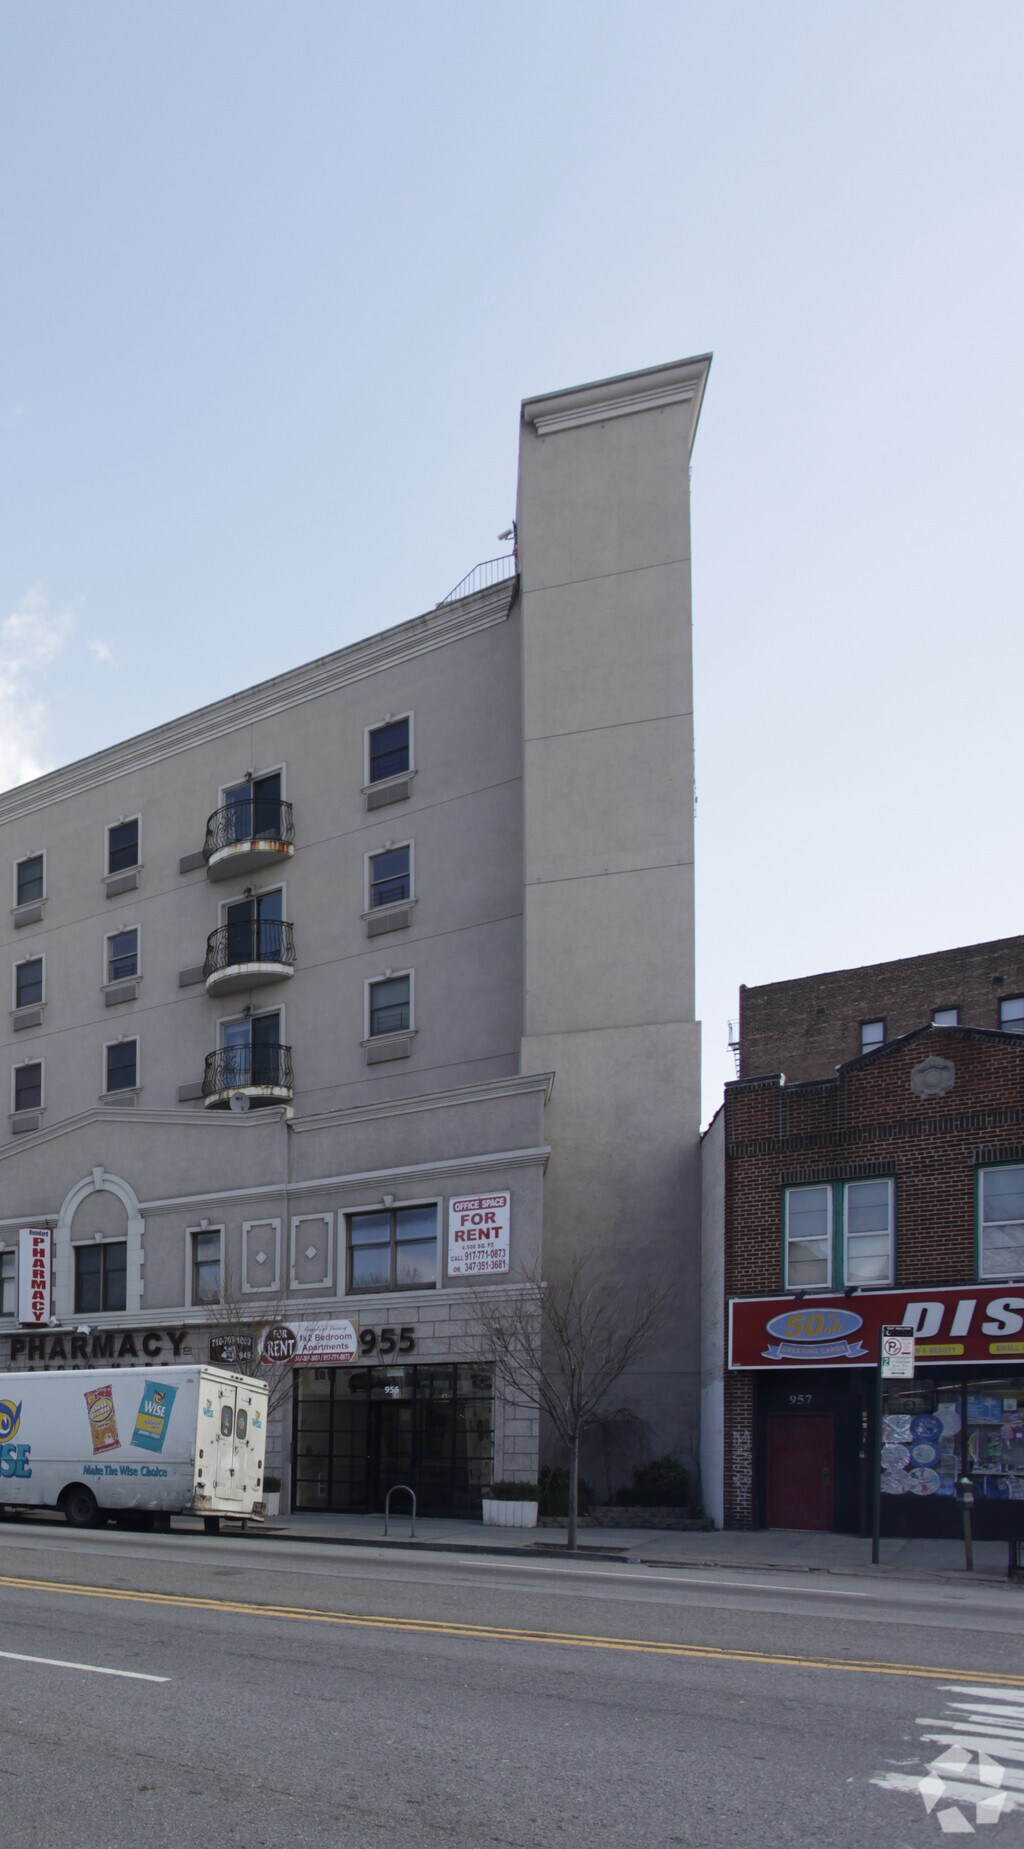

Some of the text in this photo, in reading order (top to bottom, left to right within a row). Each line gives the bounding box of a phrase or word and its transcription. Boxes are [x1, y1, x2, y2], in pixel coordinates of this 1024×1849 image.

[454, 1198, 505, 1211] OFFICE SPACE
[460, 1212, 496, 1226] FOR
[454, 1226, 503, 1242] RENT
[464, 1248, 506, 1261] 917-771-0873
[464, 1259, 506, 1272] 347-351-3681
[31, 1237, 46, 1322] PHARMACY
[902, 1297, 1024, 1339] DIS
[272, 1329, 288, 1338] FOR
[314, 1333, 352, 1342] Bedroom
[10, 1330, 189, 1361] PHARMACY
[266, 1339, 295, 1356] RENT
[302, 1343, 349, 1352] Apartments
[359, 1327, 415, 1356] 955
[789, 1395, 813, 1405] 957
[144, 1401, 166, 1417] WISE
[83, 1465, 168, 1478] Make The Wise Choice
